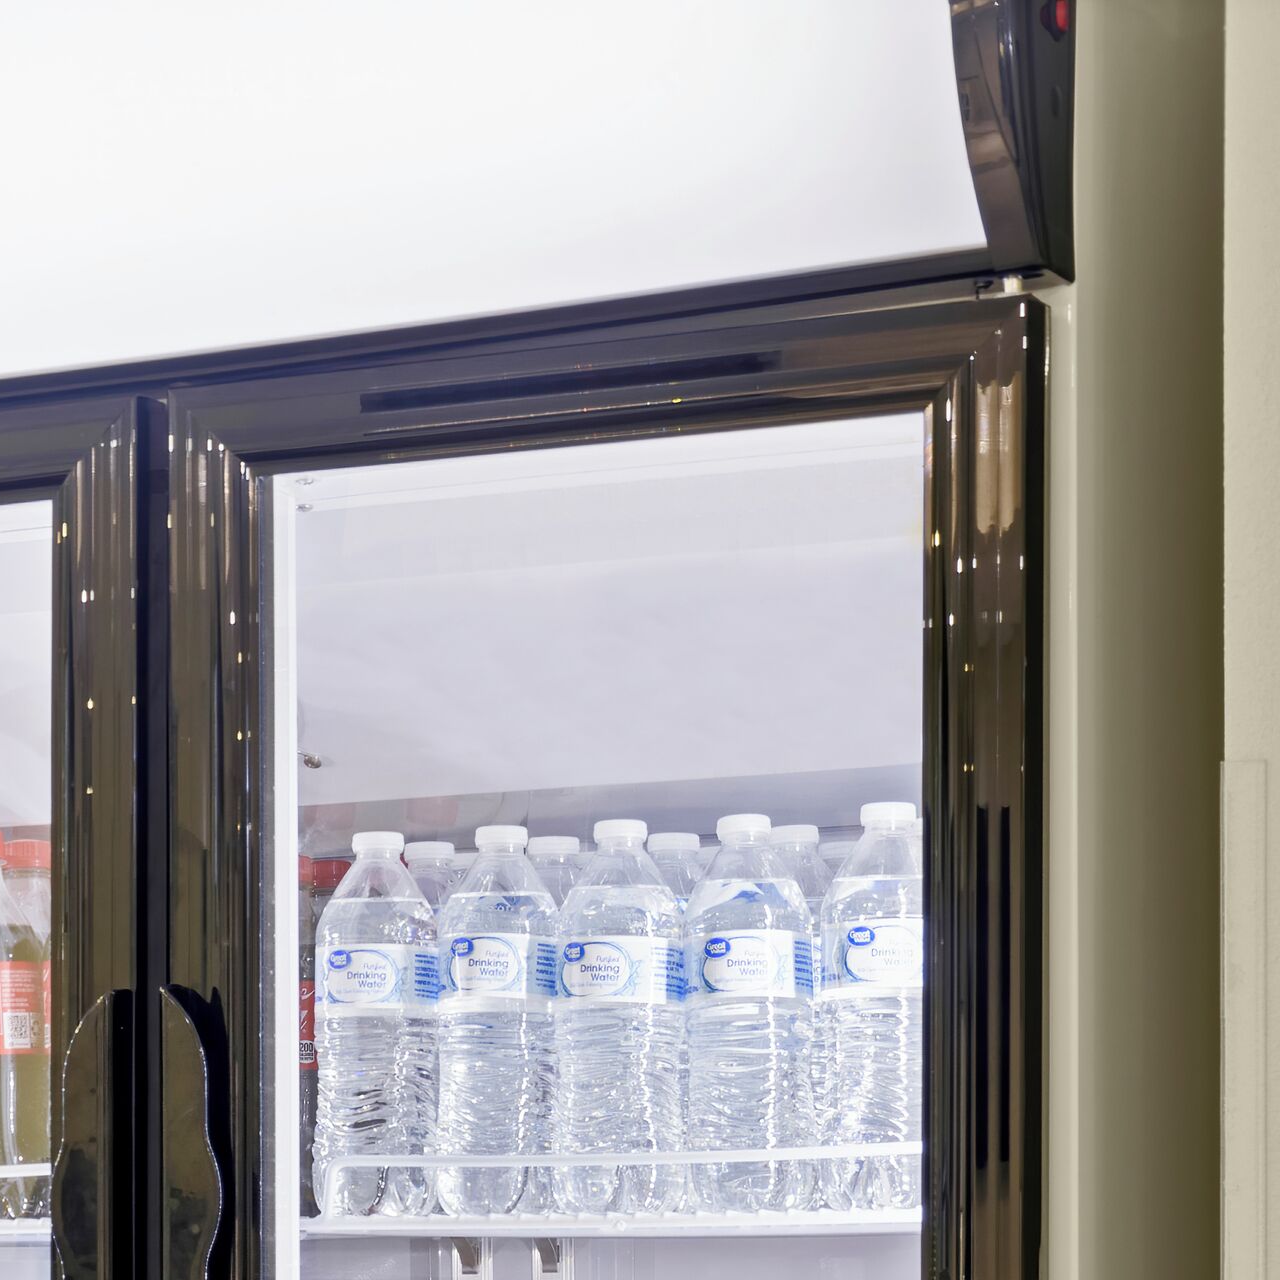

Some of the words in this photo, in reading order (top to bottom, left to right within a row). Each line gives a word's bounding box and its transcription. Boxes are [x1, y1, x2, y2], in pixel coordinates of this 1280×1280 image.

[469, 958, 509, 969] Drinking
[727, 959, 768, 969] Drinking
[480, 967, 509, 976] Water
[580, 964, 620, 975] Drinking
[347, 971, 386, 982] Drinking
[591, 973, 620, 982] Water
[358, 980, 386, 989] Water
